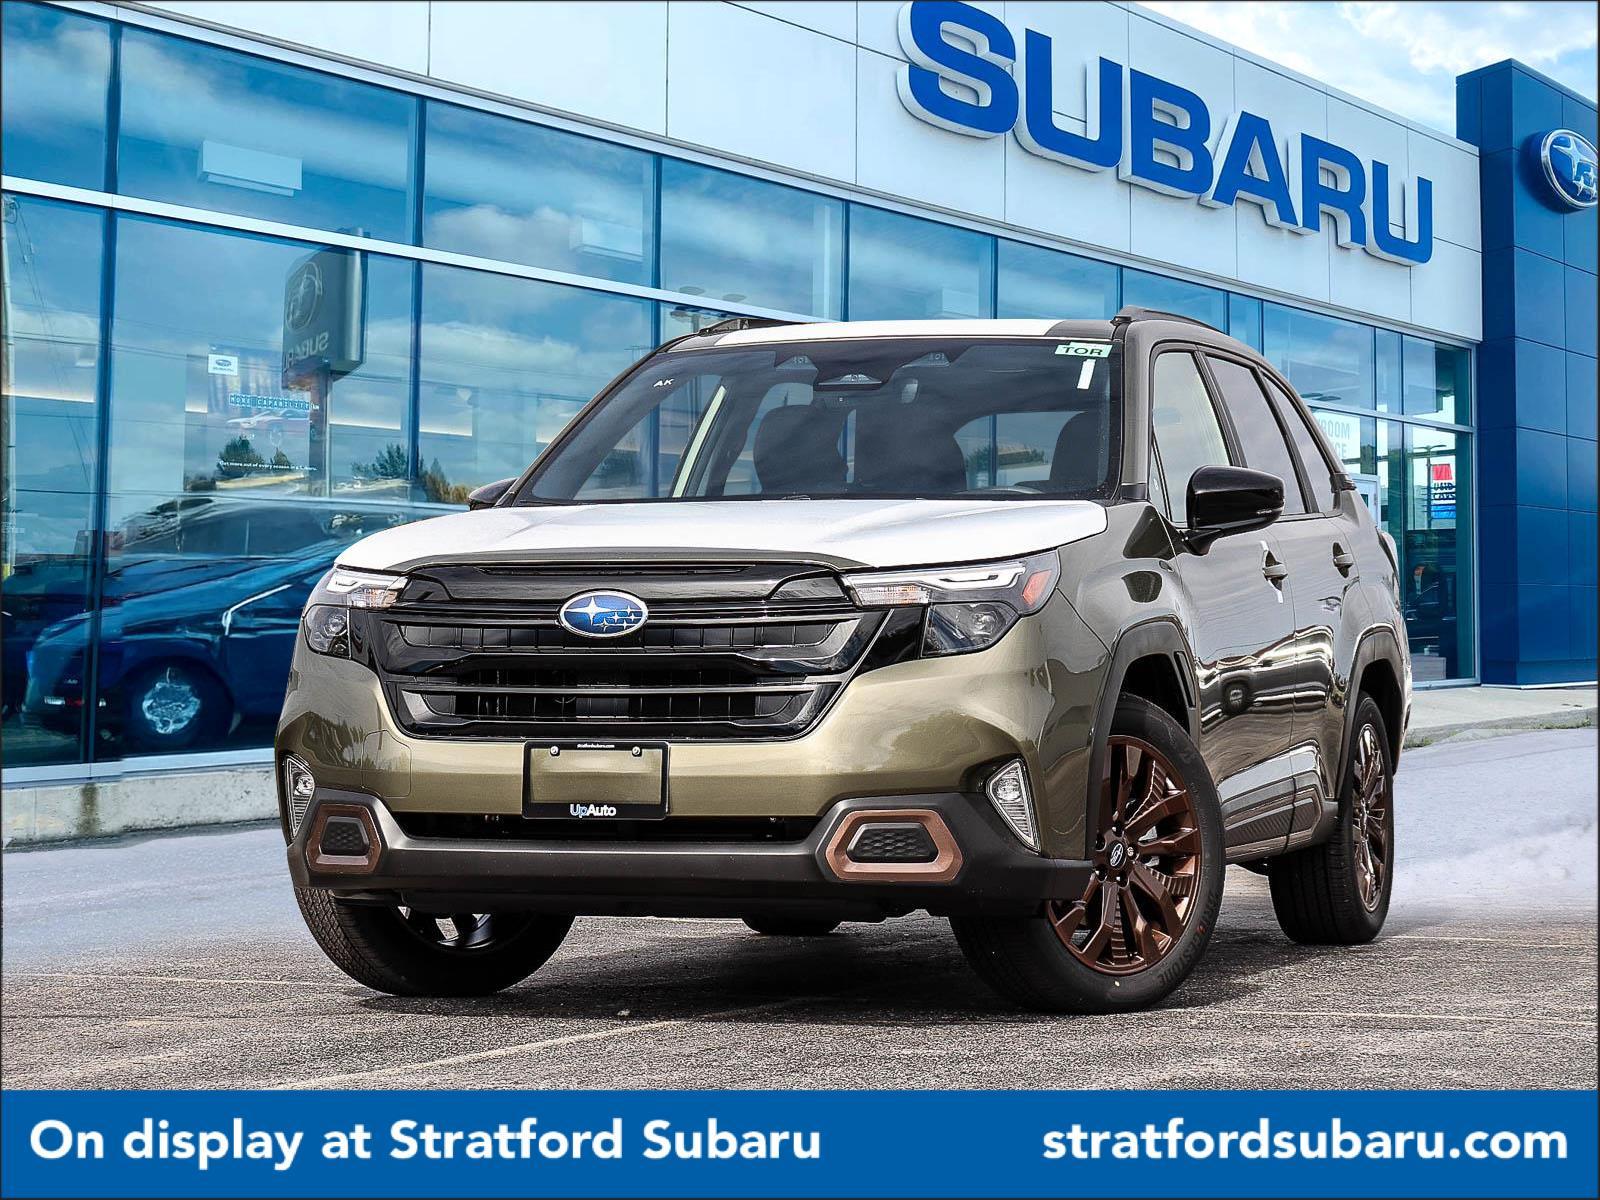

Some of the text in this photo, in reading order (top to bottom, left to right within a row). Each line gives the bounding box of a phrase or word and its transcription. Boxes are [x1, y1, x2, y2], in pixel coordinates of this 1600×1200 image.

[899, 0, 1433, 267] SUBARU
[1062, 346, 1103, 356] TOR
[569, 803, 617, 819] UpAuto
